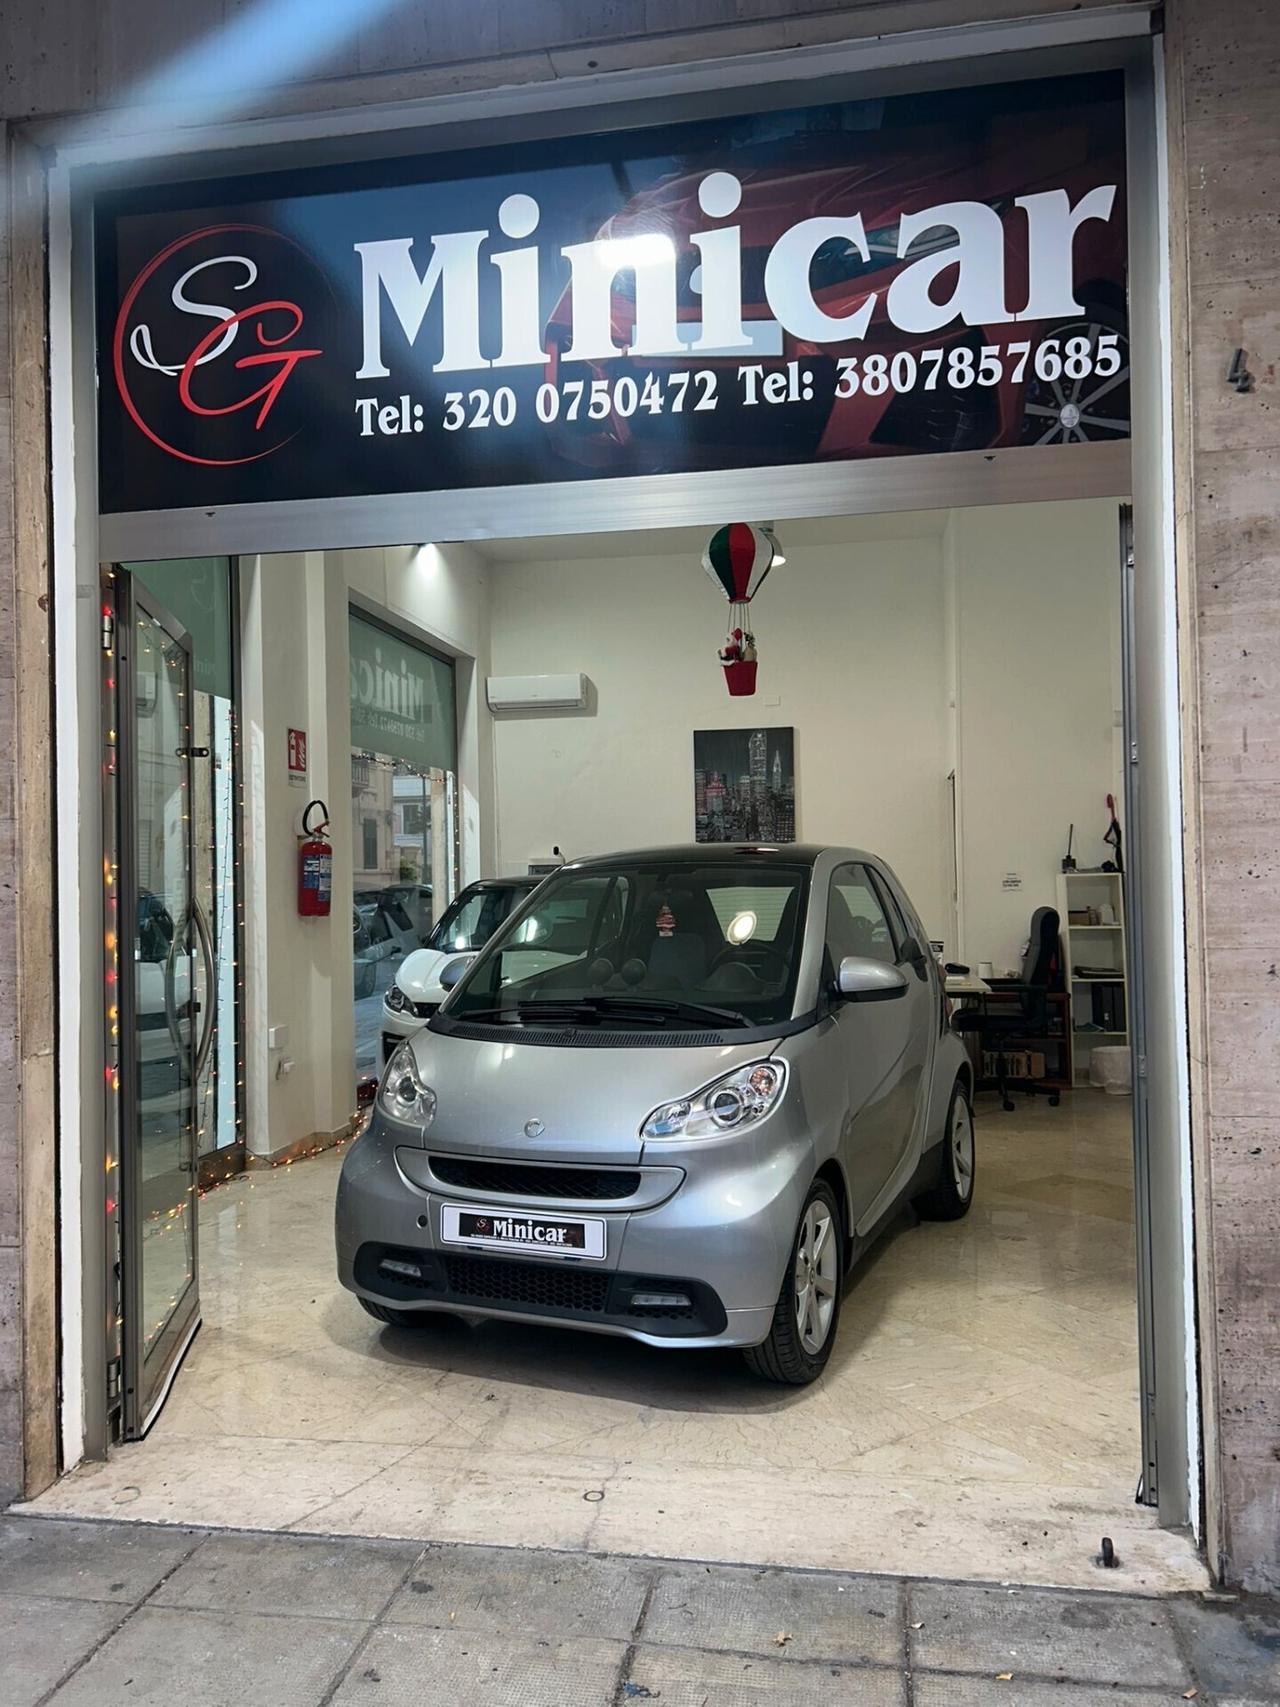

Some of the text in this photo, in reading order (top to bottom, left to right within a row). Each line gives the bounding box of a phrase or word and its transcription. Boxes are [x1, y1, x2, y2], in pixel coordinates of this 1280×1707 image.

[354, 171, 1117, 379] Minicar
[354, 334, 1122, 438] Tel: 320 0750472 Tel: 3807857685
[1226, 348, 1250, 393] 4
[493, 1217, 567, 1242] Minicar
